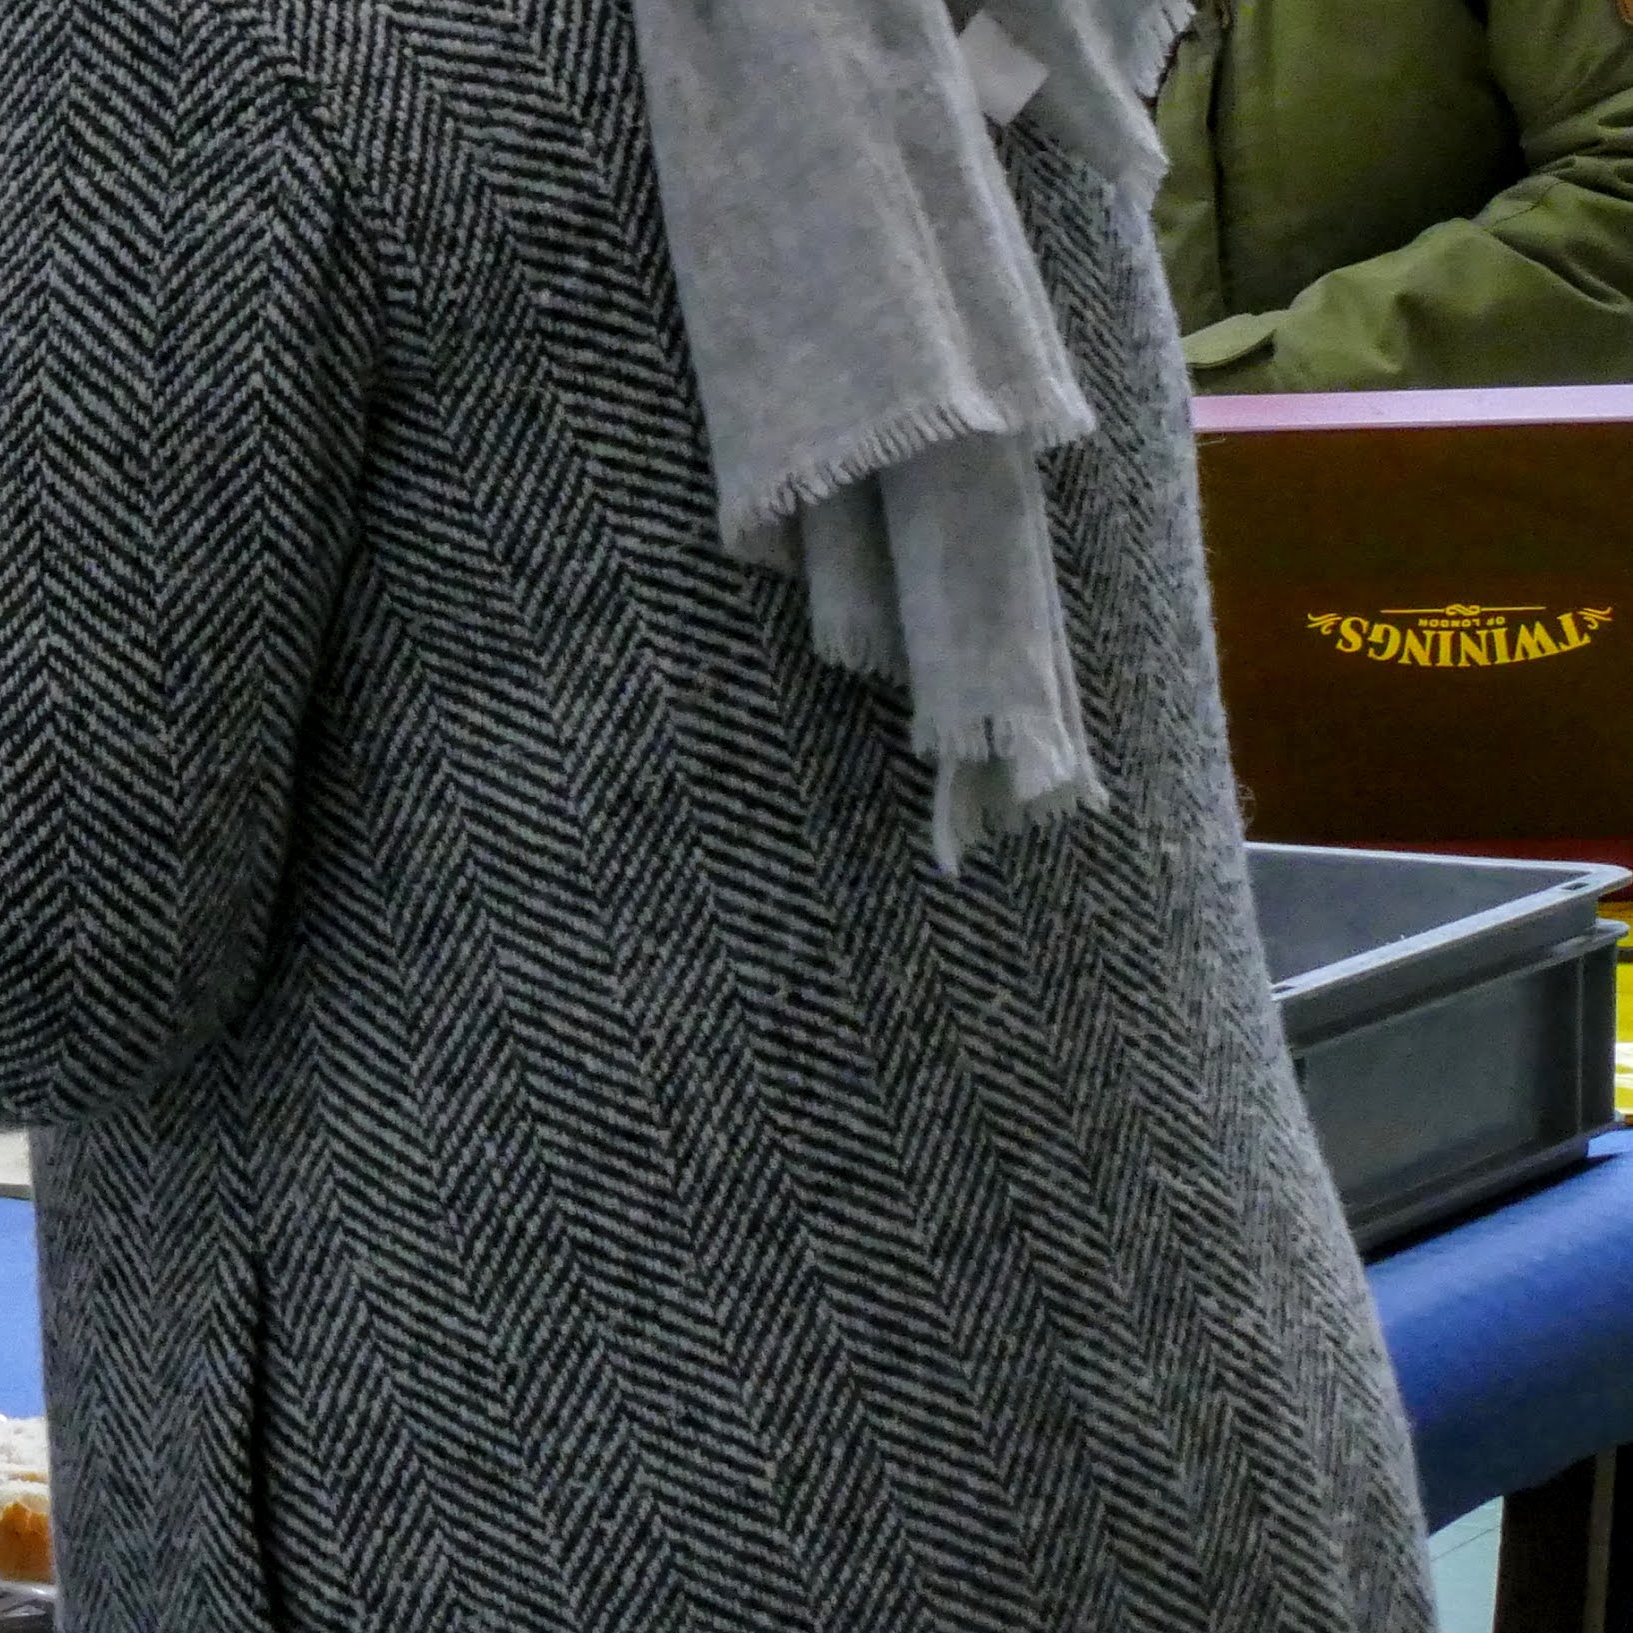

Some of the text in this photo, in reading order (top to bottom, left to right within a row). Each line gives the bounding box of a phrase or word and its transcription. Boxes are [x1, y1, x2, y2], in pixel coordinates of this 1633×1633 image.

[1418, 615, 1506, 628] OF LONDON
[1336, 612, 1591, 667] TWININGS
